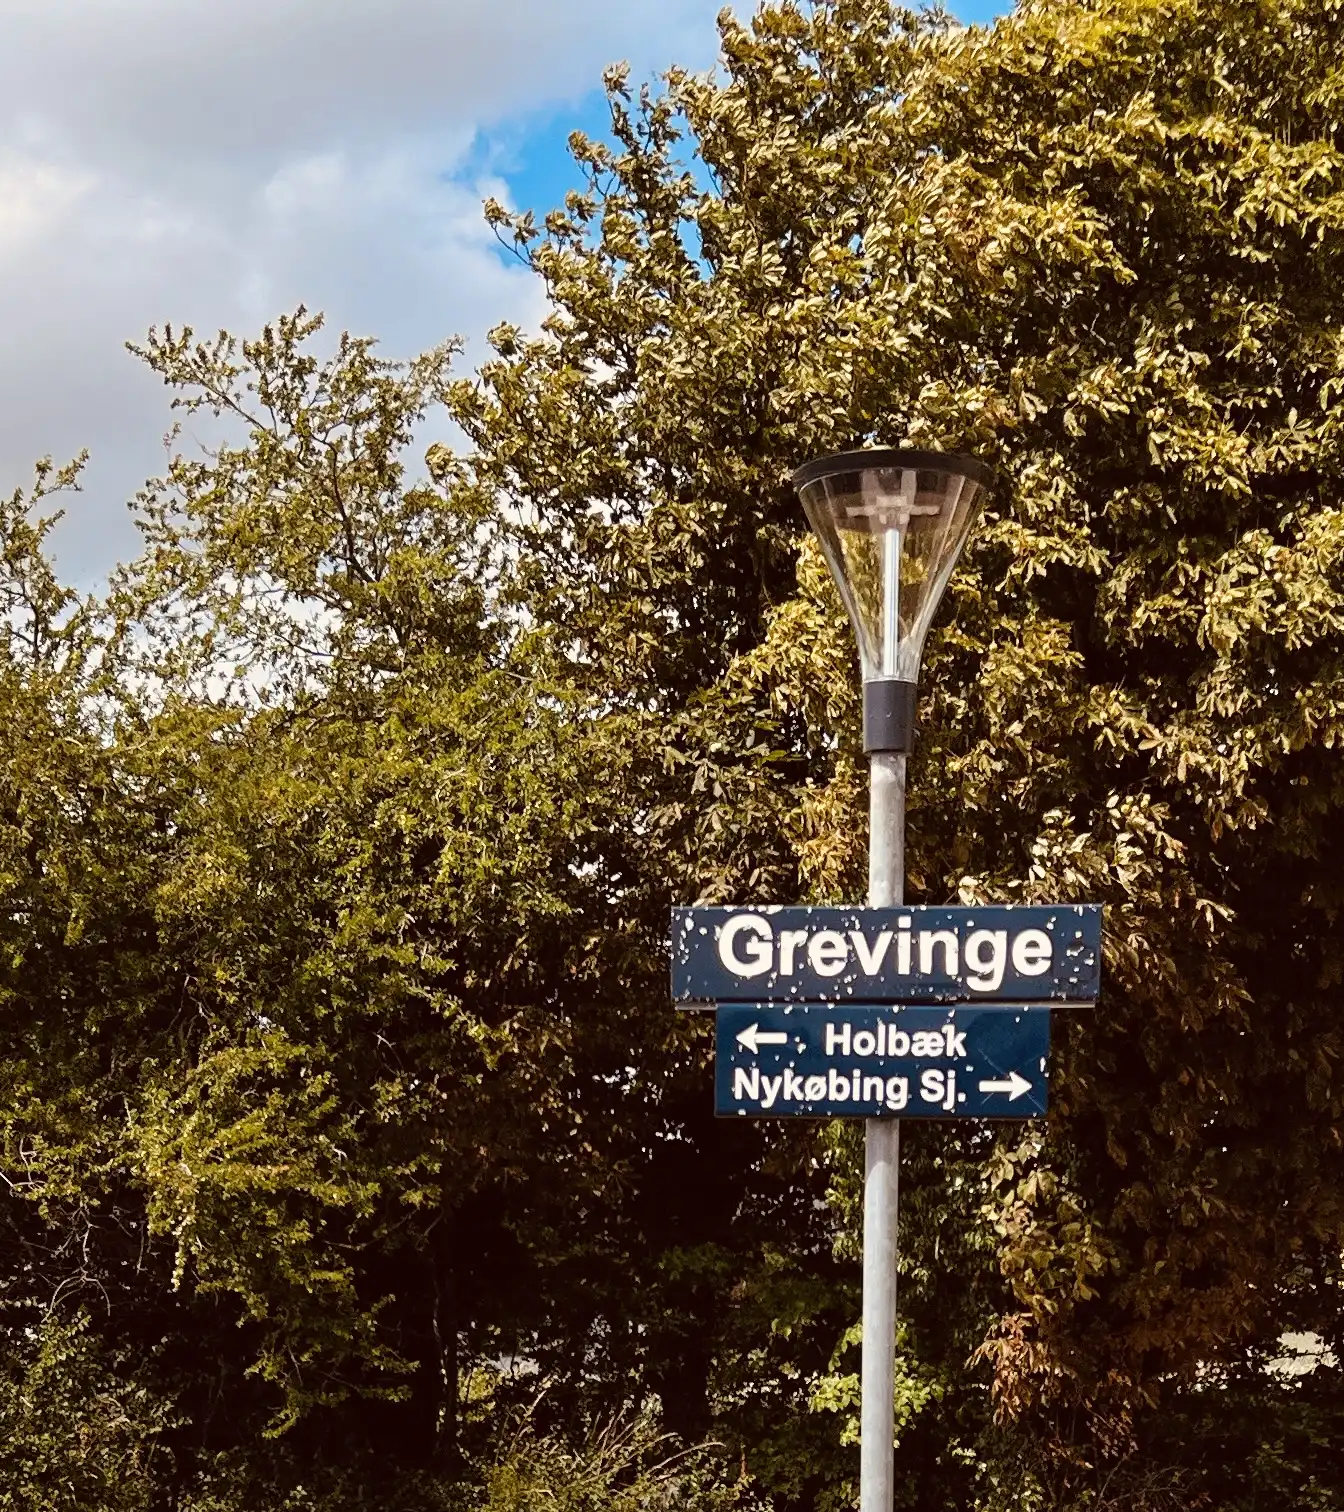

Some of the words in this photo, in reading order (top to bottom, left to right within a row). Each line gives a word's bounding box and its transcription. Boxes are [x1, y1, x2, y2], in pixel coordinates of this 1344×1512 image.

[718, 914, 1052, 992] Grevinge
[825, 1023, 967, 1057] Holbæk
[733, 1068, 908, 1109] Nykøbing
[920, 1069, 966, 1110] Sj.
